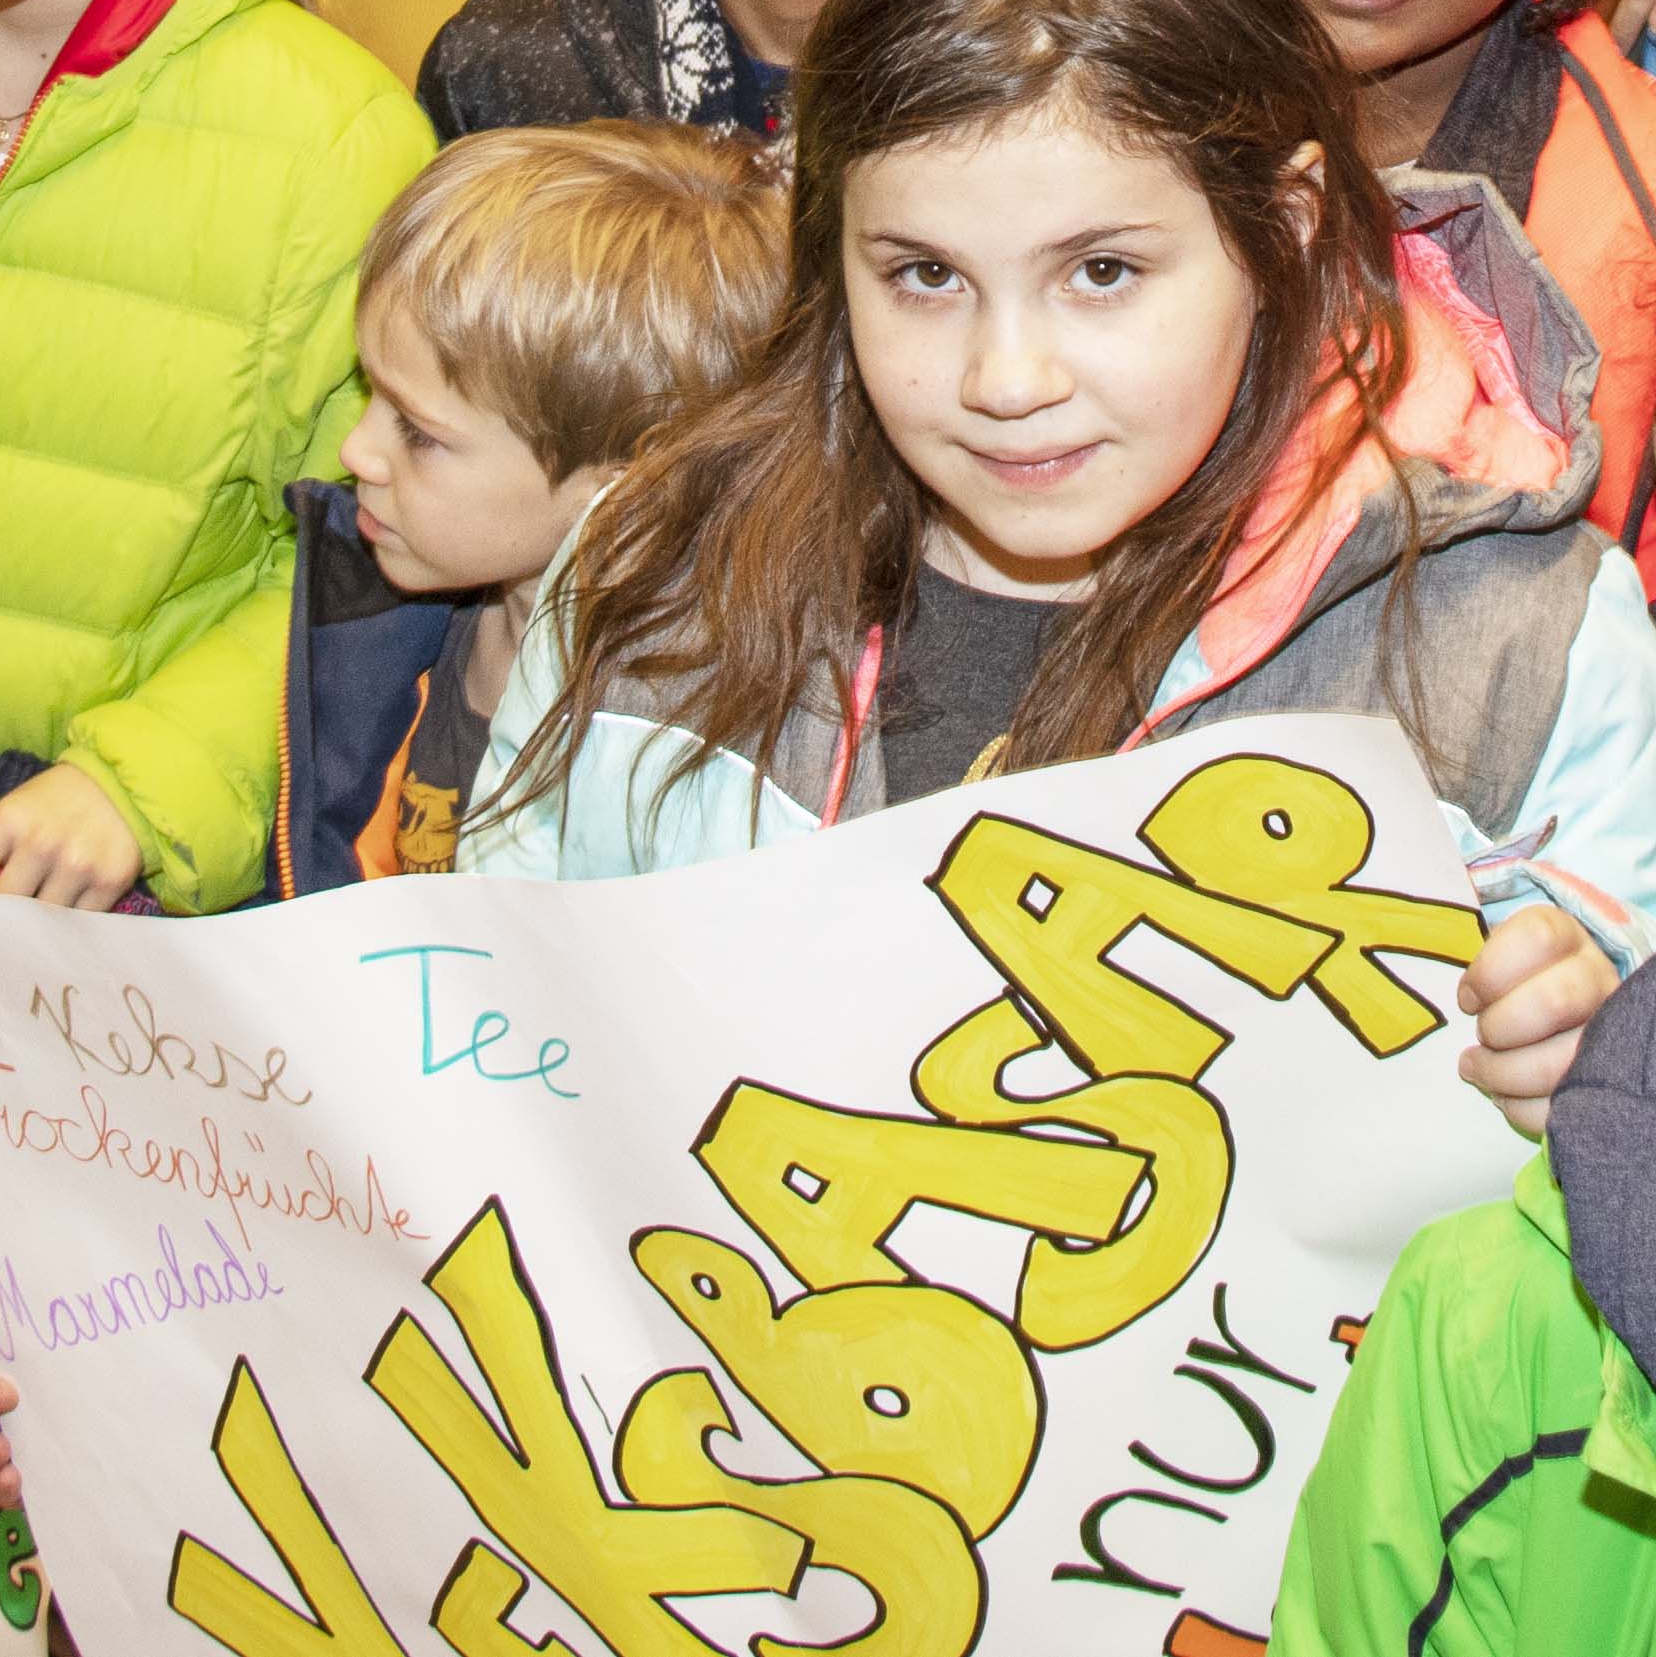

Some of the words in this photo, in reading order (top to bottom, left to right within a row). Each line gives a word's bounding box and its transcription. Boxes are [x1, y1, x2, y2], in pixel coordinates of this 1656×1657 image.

[30, 984, 313, 1107] Kekse
[359, 944, 581, 1100] Tee
[1050, 1281, 1318, 1600] nur
